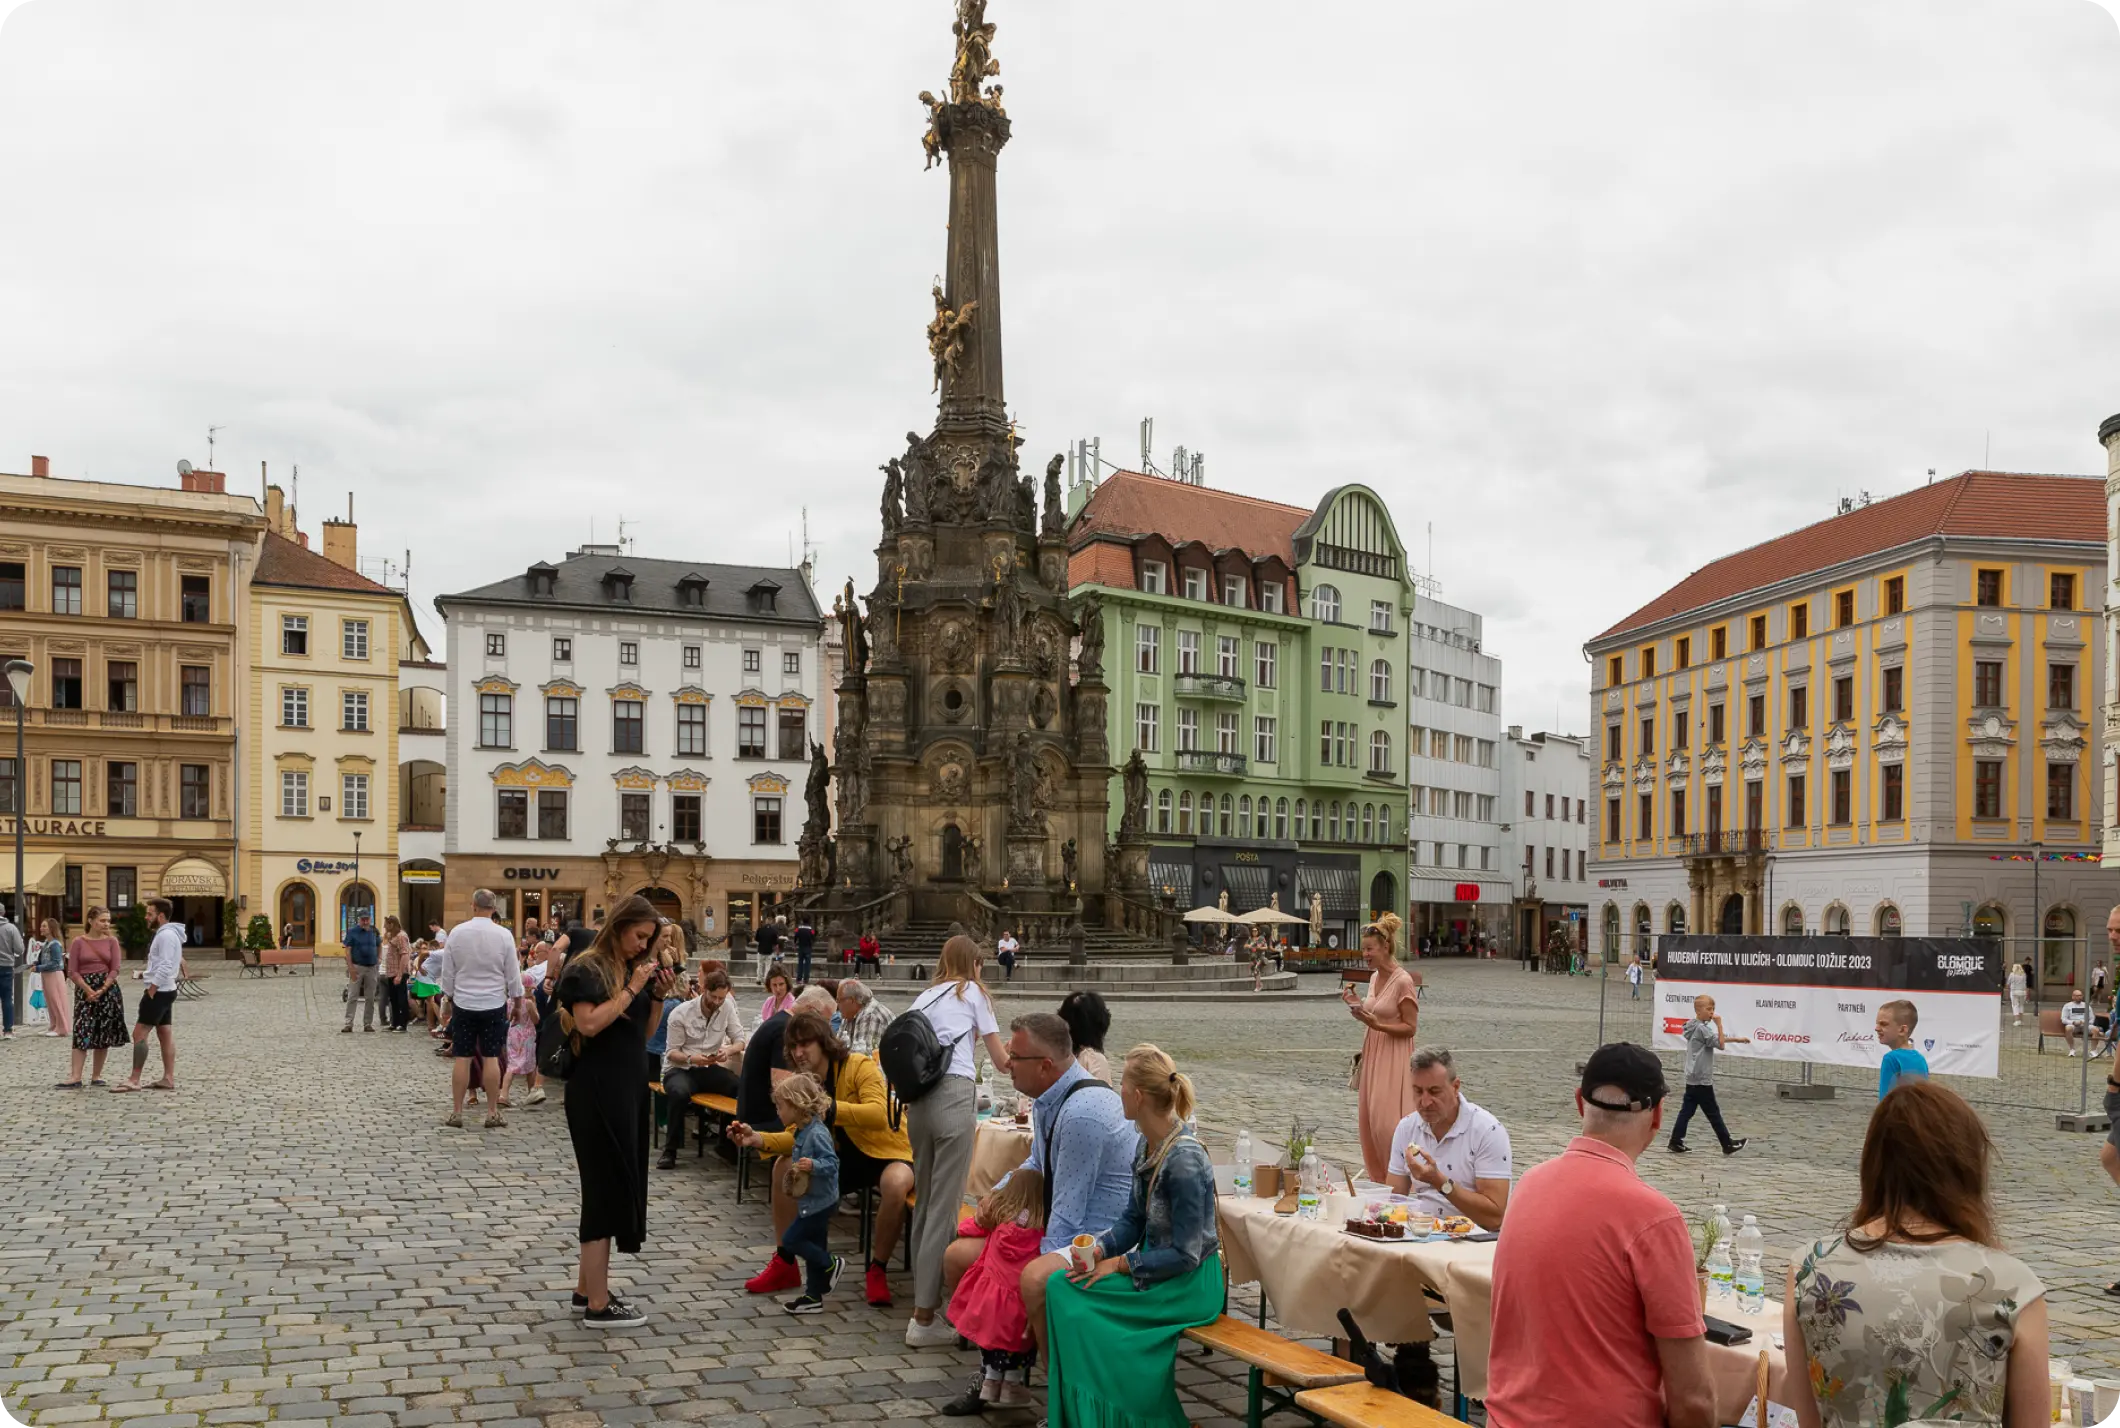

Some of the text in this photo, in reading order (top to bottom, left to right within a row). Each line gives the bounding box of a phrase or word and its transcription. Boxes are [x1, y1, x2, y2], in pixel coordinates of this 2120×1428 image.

[503, 867, 561, 880] OBUV
[1667, 949, 1699, 964] HUDEBNÍ
[1700, 952, 1733, 965] FESTIVAL
[1734, 953, 1740, 966] V
[1741, 951, 1771, 966] ULICÍCH
[1777, 953, 1815, 967] OLOMOUC
[1848, 955, 1872, 969] 2023
[1774, 1000, 1796, 1009] PARTNER
[1757, 1031, 1811, 1044] EDWARDS
